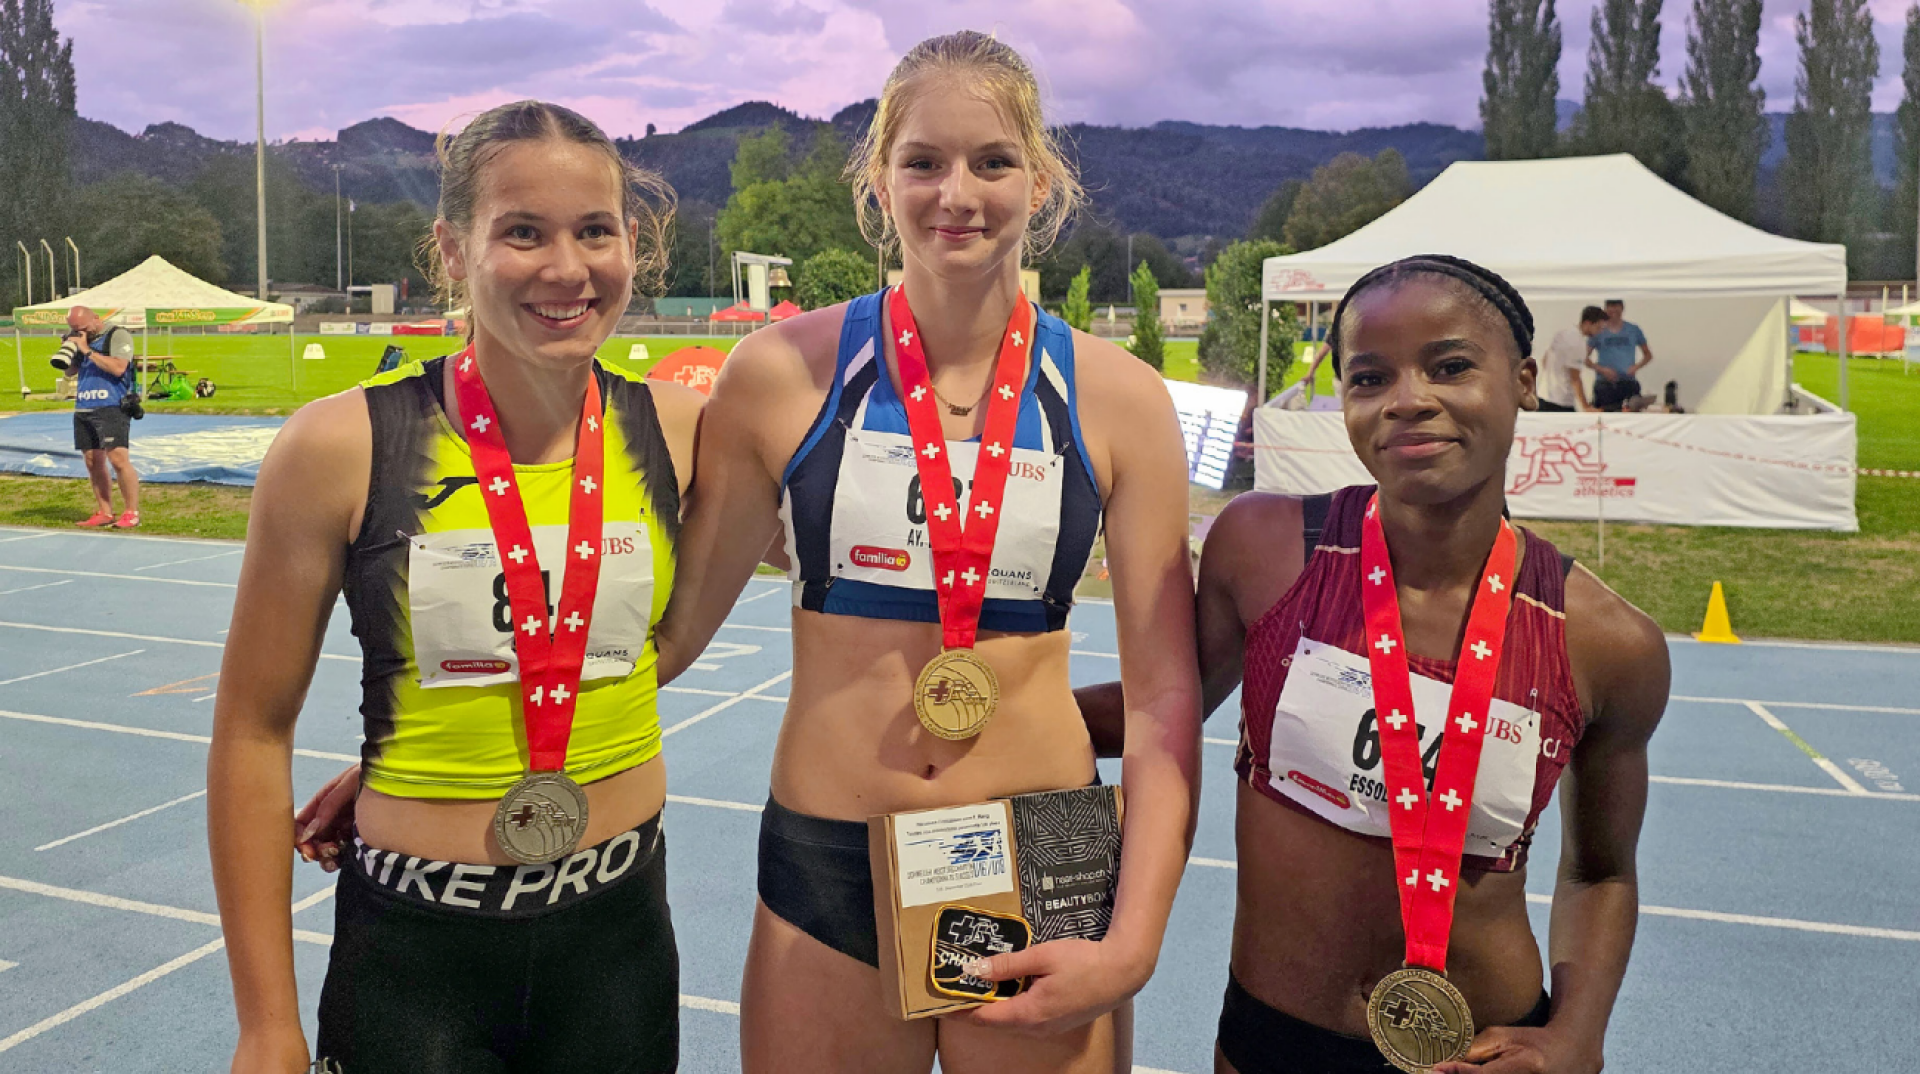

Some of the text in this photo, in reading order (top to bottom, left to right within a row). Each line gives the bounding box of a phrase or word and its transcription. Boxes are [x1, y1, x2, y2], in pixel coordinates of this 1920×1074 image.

[78, 389, 109, 400] FOTO
[1008, 462, 1045, 482] UBS
[1574, 487, 1635, 498] athletics
[855, 549, 896, 565] familia
[988, 569, 1032, 579] QUANS
[586, 650, 628, 659] QUANS
[1353, 708, 1444, 792] 64
[354, 830, 641, 911] NIKE PRO
[1045, 892, 1107, 911] BEAUTYBOX
